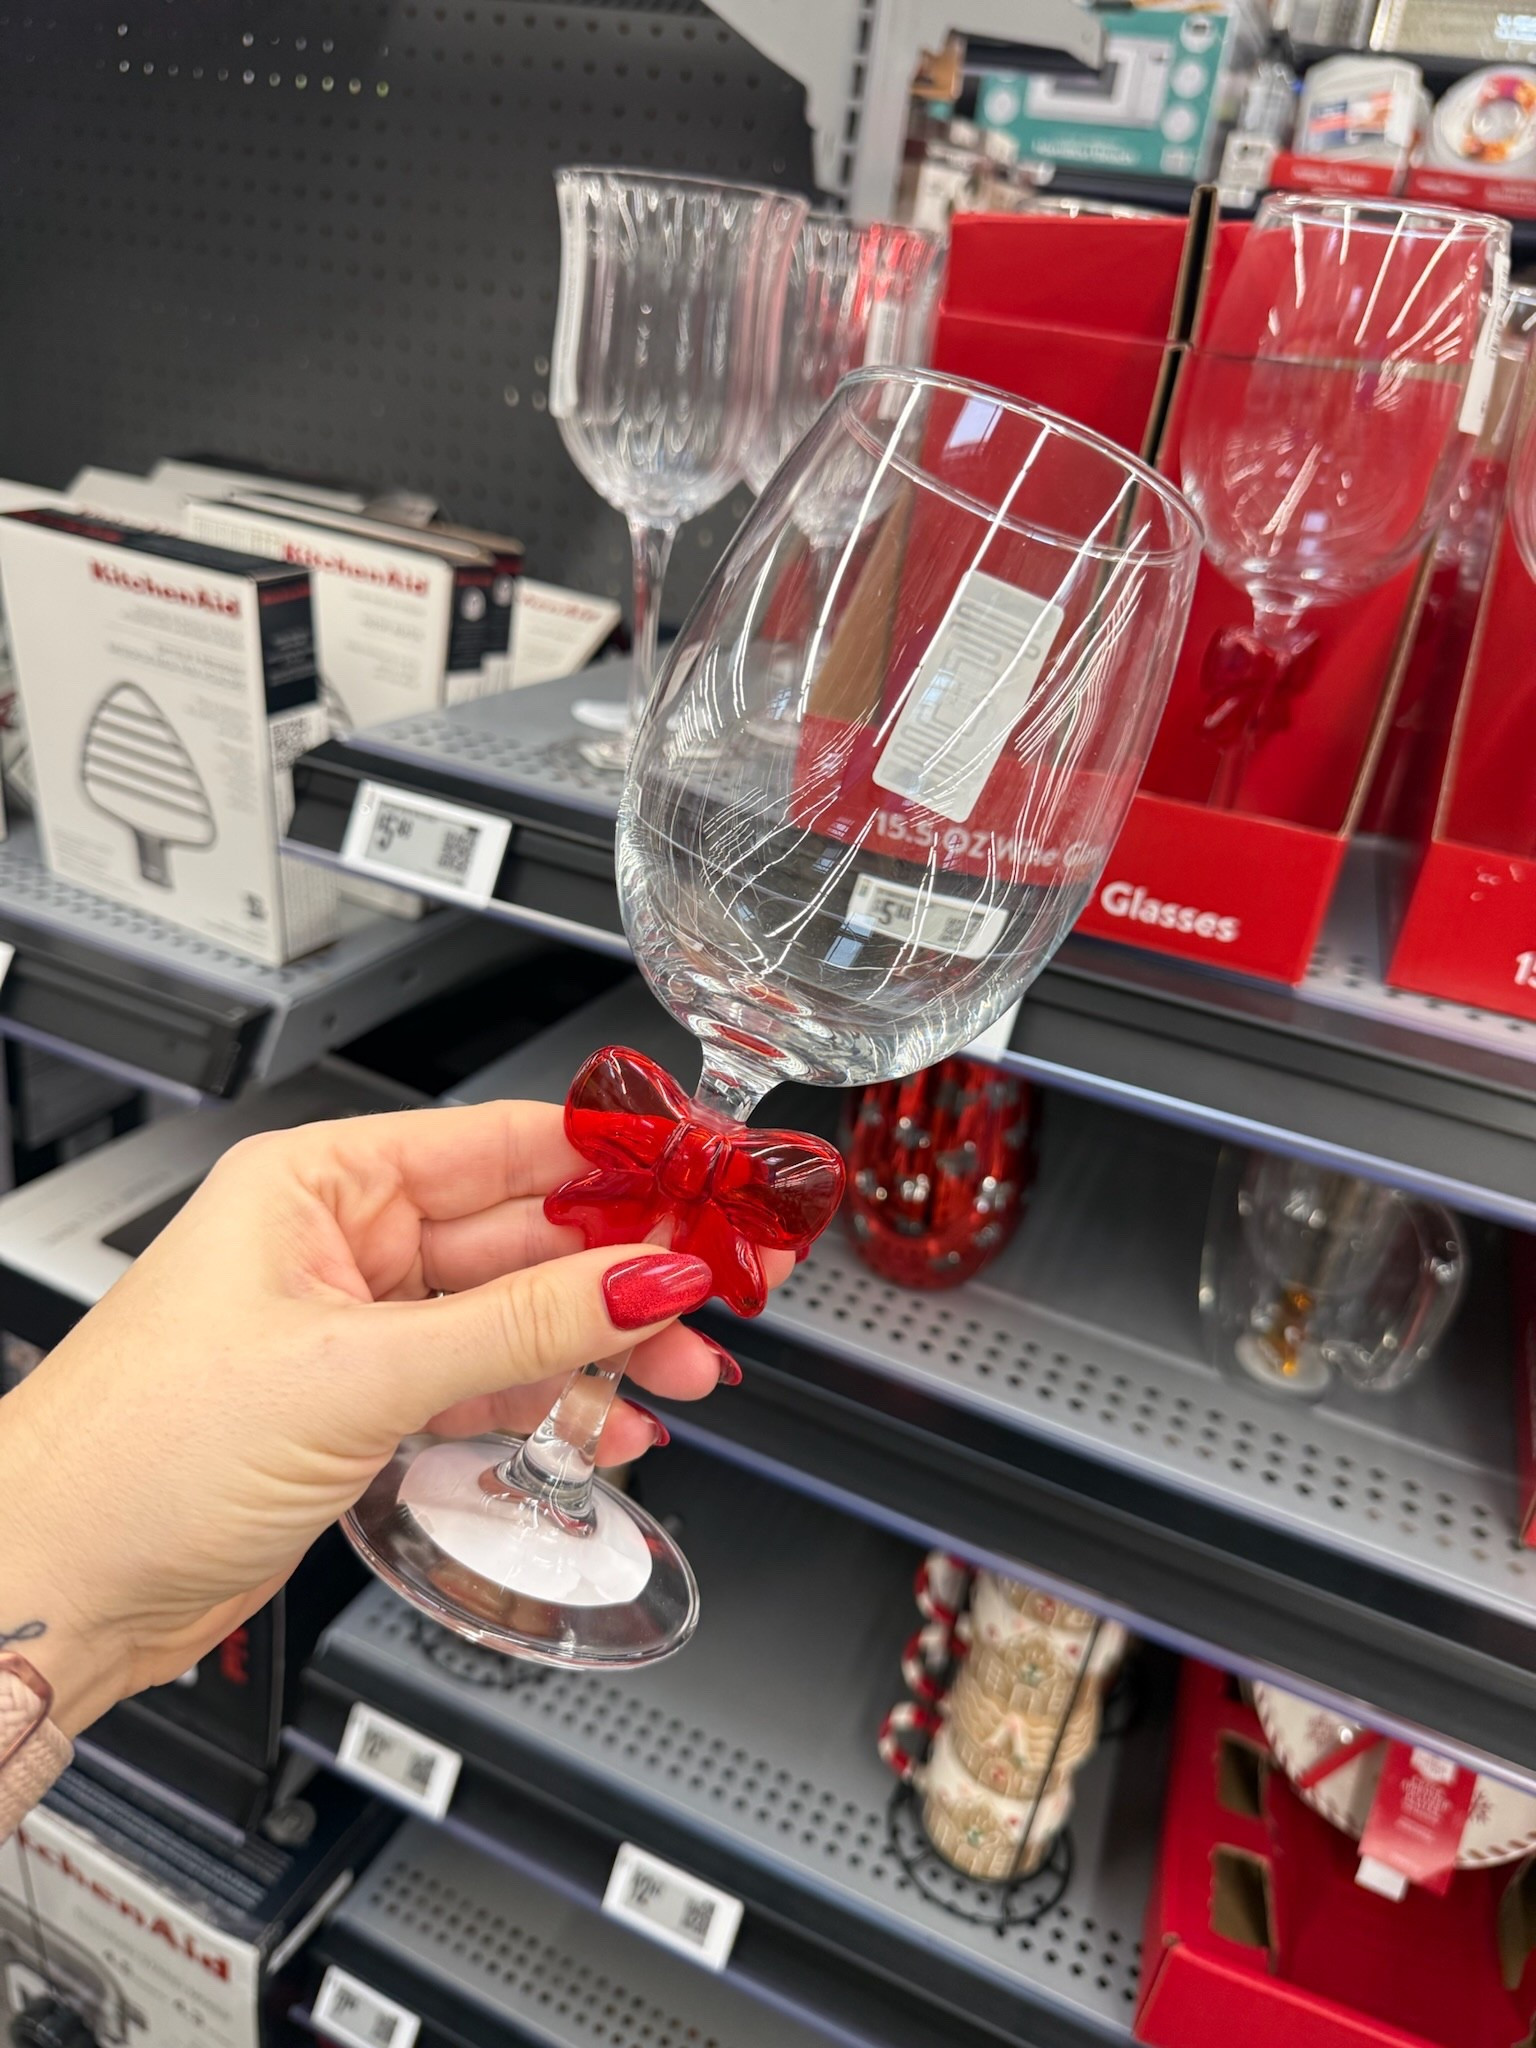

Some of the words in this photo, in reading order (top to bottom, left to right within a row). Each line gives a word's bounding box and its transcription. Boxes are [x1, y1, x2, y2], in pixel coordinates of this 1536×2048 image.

[91, 559, 241, 619] KitchenAid
[875, 811, 934, 846] 15.5
[1100, 880, 1241, 943] Glasses
[1513, 950, 1536, 989] 1
